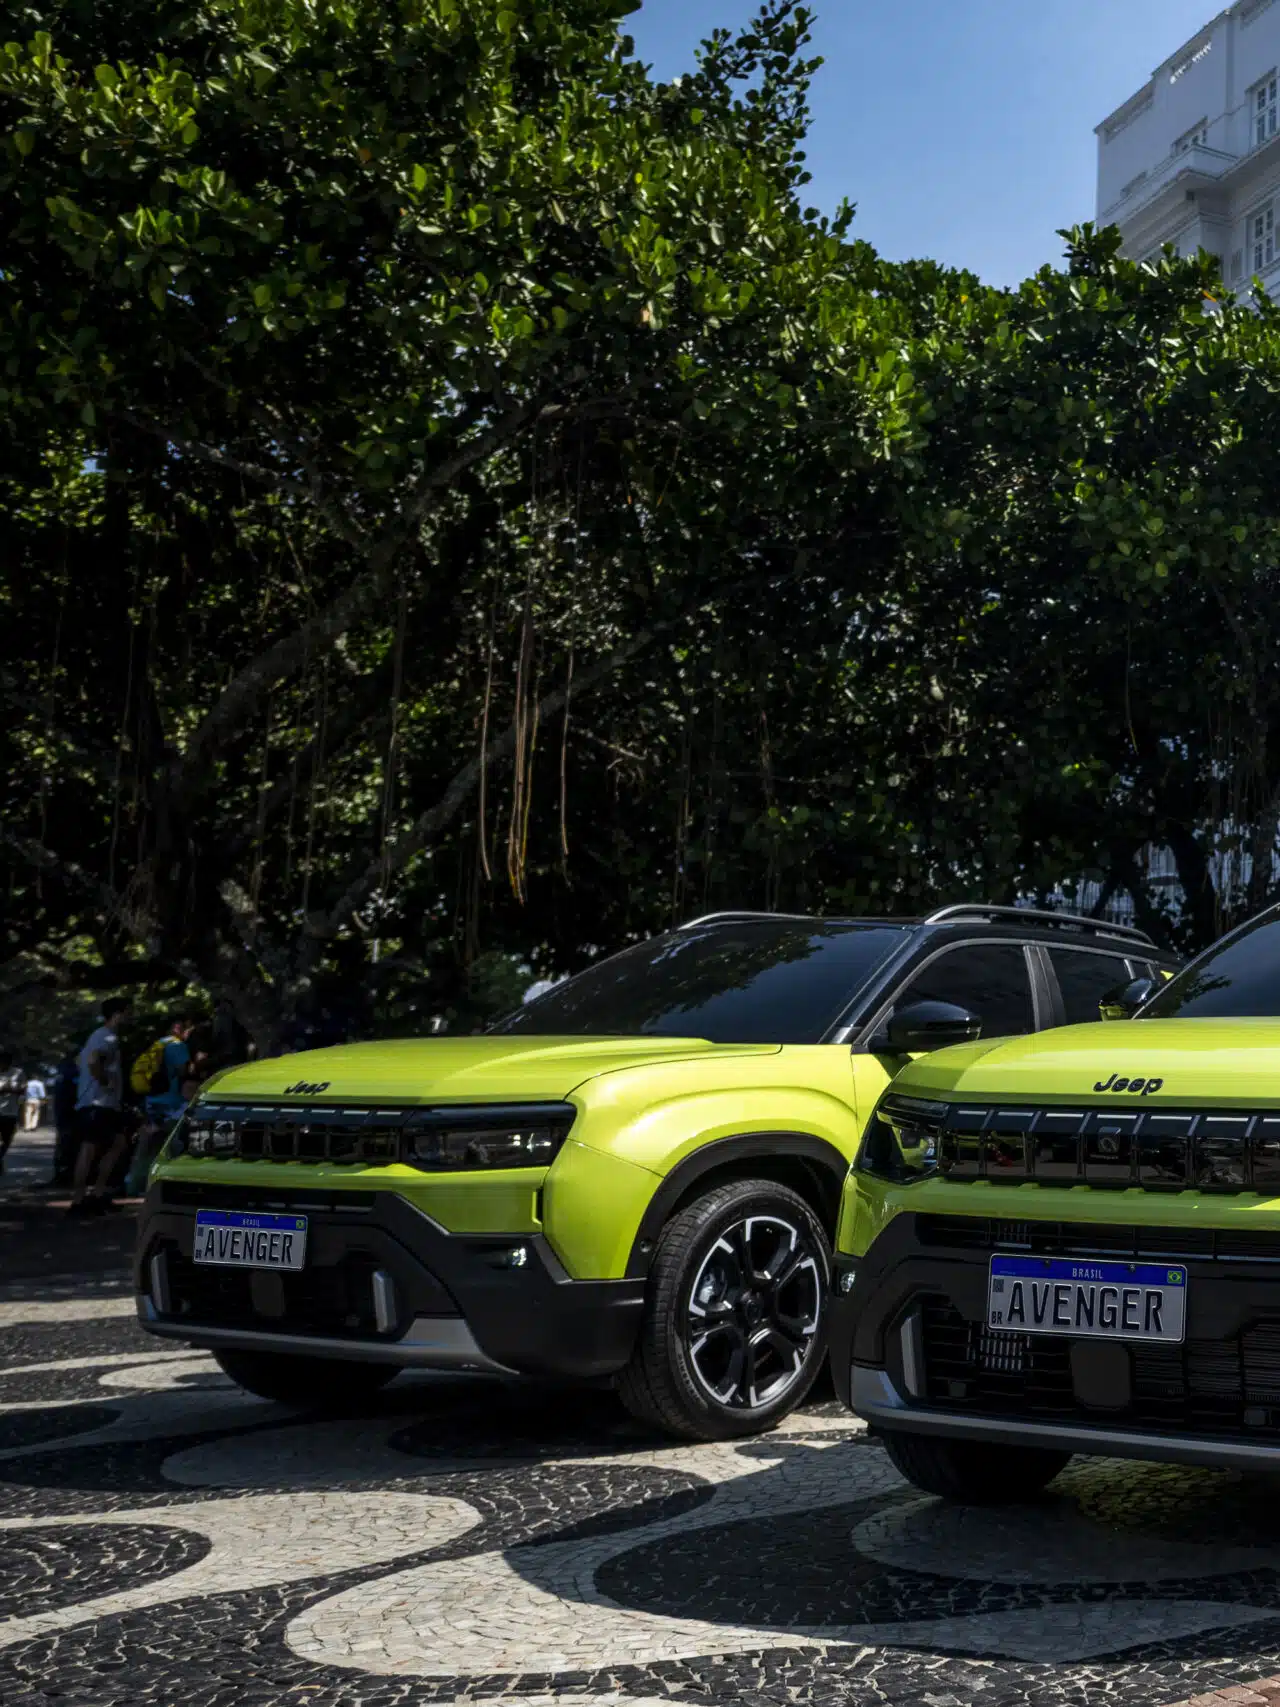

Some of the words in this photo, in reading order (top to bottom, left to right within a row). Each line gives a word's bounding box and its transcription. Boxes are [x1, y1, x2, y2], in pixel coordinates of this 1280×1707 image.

[283, 1079, 330, 1096] Jeep
[1093, 1073, 1163, 1096] Jeep
[205, 1228, 294, 1263] AVENGER
[1072, 1267, 1103, 1279] BRASIL
[1007, 1280, 1164, 1332] AVENGER
[991, 1310, 1003, 1325] BR
